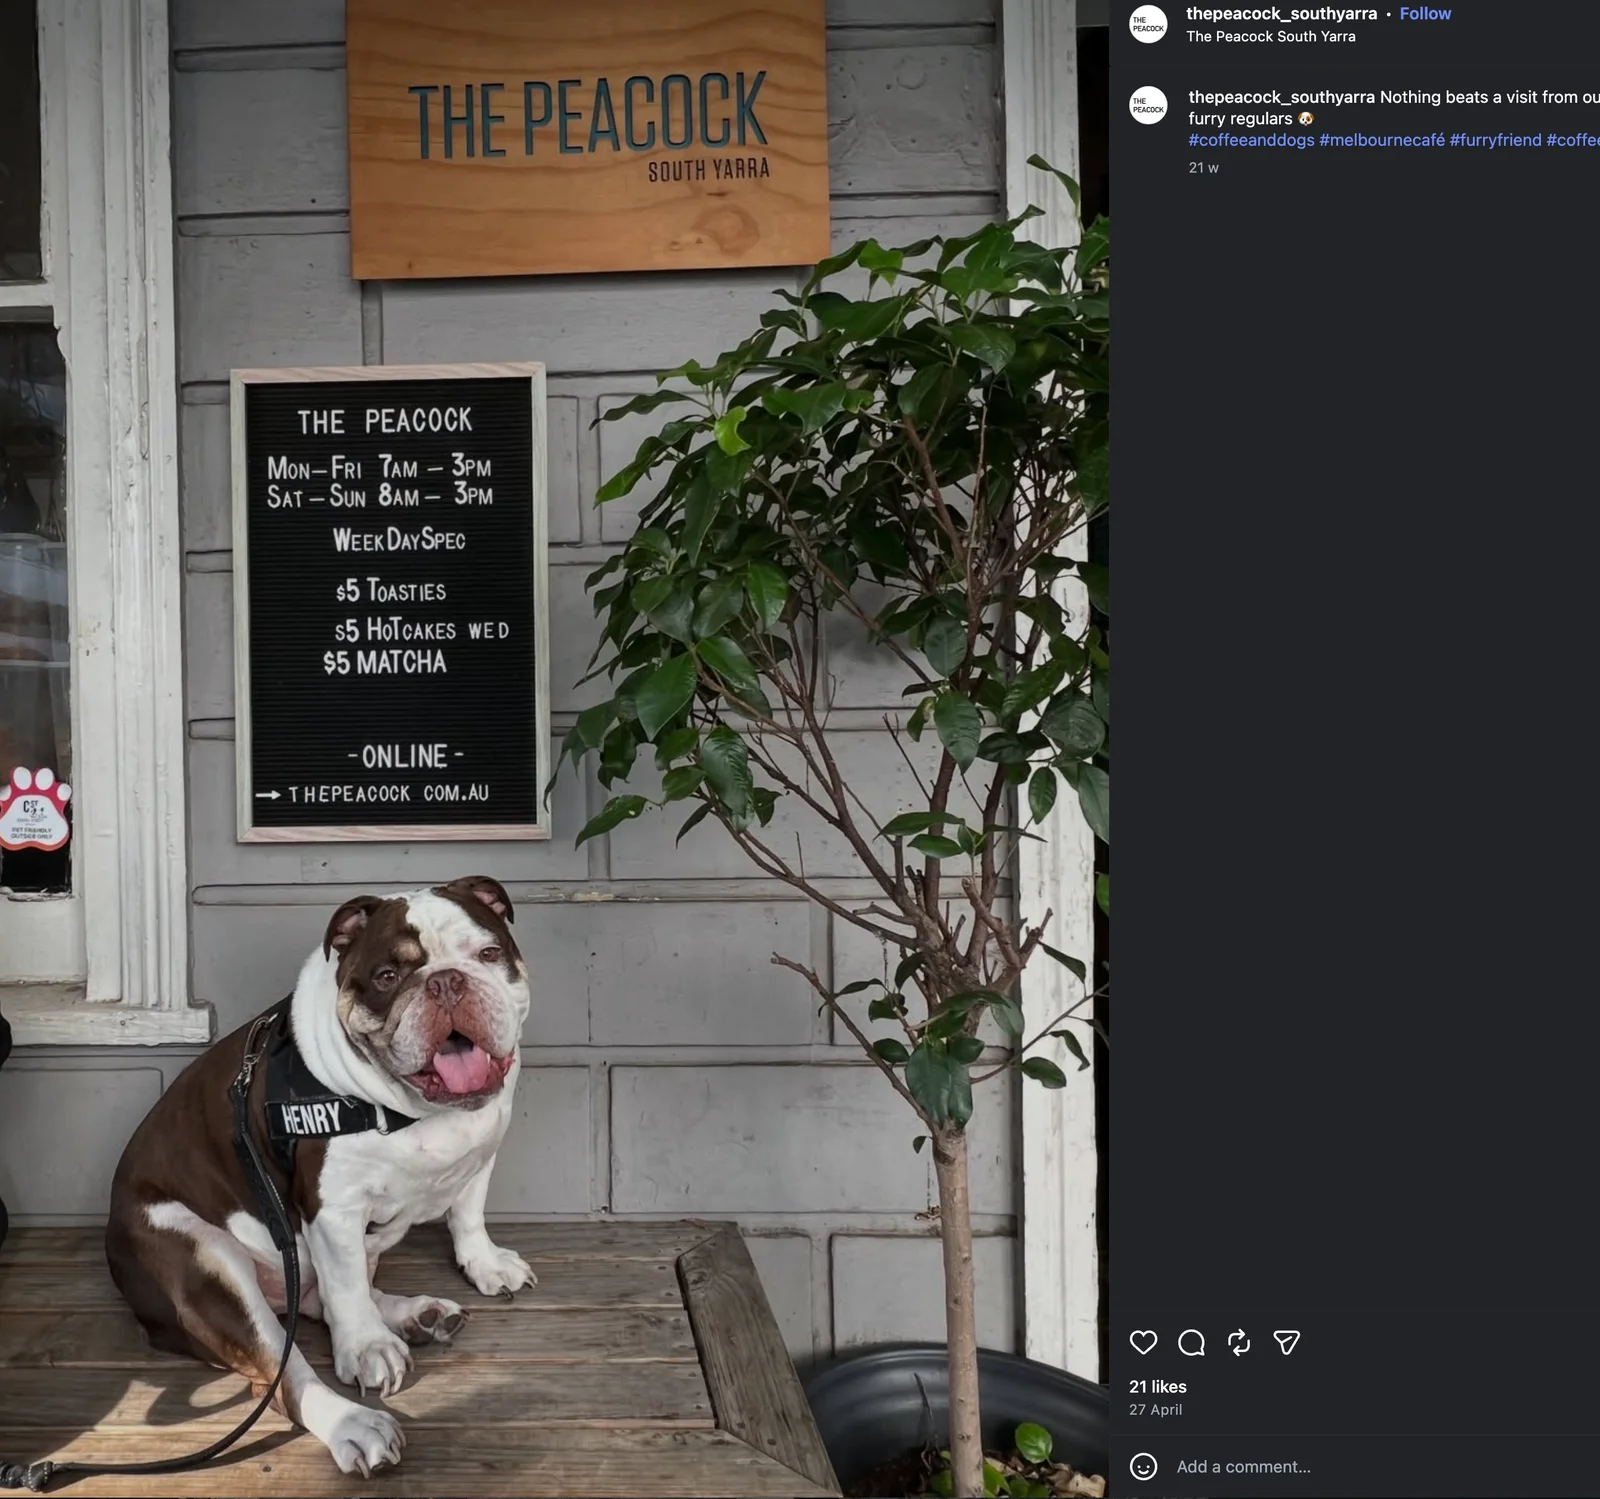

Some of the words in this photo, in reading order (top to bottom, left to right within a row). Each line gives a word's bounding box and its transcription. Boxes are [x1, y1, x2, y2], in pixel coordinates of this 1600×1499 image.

[408, 82, 507, 160] THE
[523, 70, 769, 156] PEACOCK
[648, 159, 706, 183] SOUTH
[713, 156, 771, 180] YARRA
[297, 409, 346, 435] THE
[365, 406, 473, 434] PEACOCK
[336, 578, 361, 602] $5
[366, 577, 447, 602] TOASTIES
[468, 622, 510, 640] WED
[323, 650, 351, 676] $5
[356, 649, 448, 674] MATCHA
[288, 786, 411, 803] THEPEACOCK
[423, 783, 490, 802] COM.AU
[281, 1101, 341, 1135] HENRY
